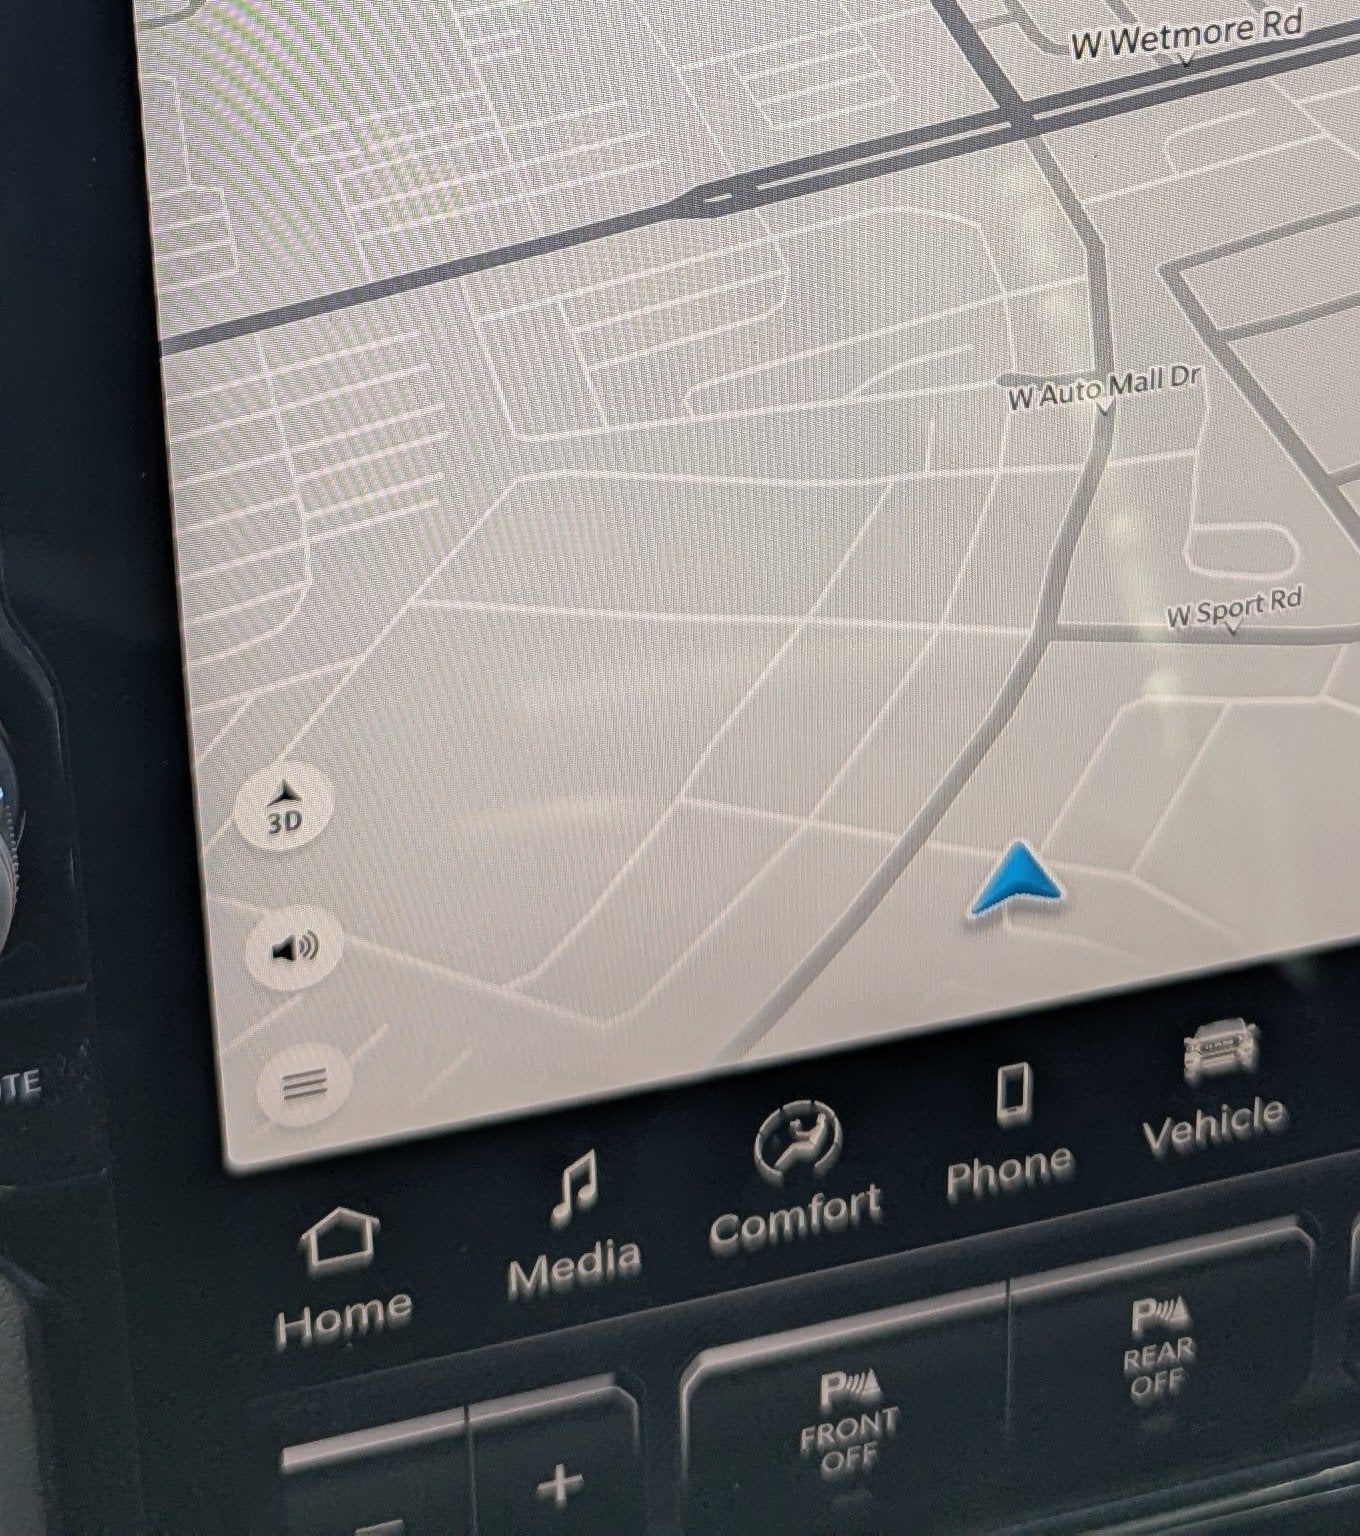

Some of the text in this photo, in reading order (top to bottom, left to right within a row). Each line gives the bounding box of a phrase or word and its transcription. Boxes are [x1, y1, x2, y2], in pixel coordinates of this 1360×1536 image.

[1071, 7, 1305, 60] W Wetmore Rd
[1008, 365, 1202, 411] W Auto Mall Dr
[1166, 586, 1303, 629] W Sport Rd
[267, 810, 303, 836] 3D
[1143, 1095, 1287, 1156] Vehicle
[947, 1145, 1073, 1202] Phone
[709, 1182, 882, 1252] Comfort
[507, 1239, 642, 1299] Media
[275, 1291, 413, 1348] Home
[1123, 1335, 1196, 1373] REAR
[1130, 1368, 1185, 1400] OFF
[800, 1405, 900, 1452] FRONT
[820, 1440, 879, 1476] OFF
